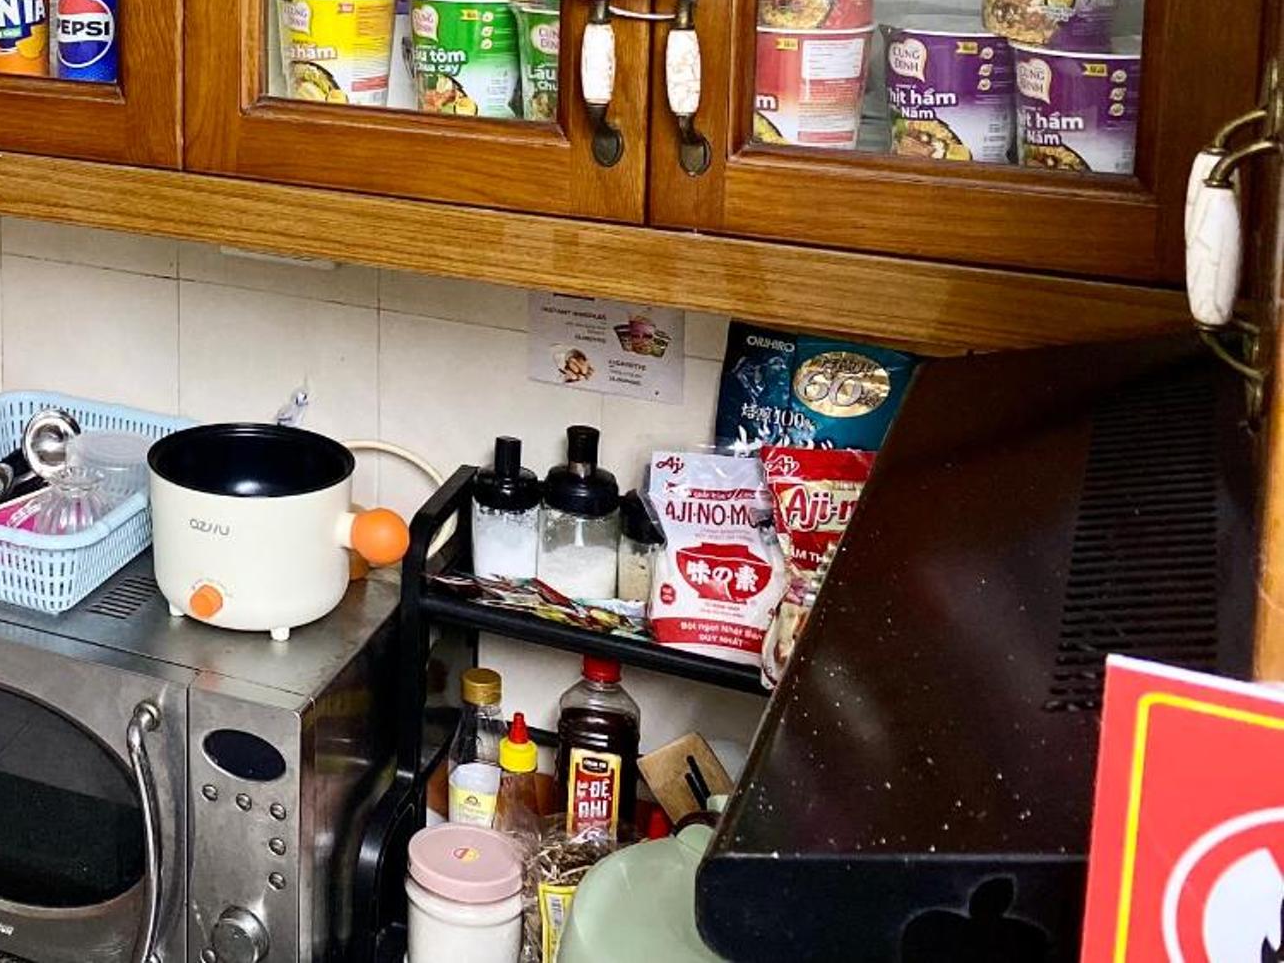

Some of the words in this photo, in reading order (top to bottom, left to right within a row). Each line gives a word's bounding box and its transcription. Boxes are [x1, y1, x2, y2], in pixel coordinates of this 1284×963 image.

[429, 48, 466, 63] tôm
[893, 45, 920, 60] CUNG
[438, 63, 460, 75] cay
[746, 335, 796, 353] ORIHIRO
[786, 485, 858, 532] Aji-n
[685, 558, 759, 593] 味の素
